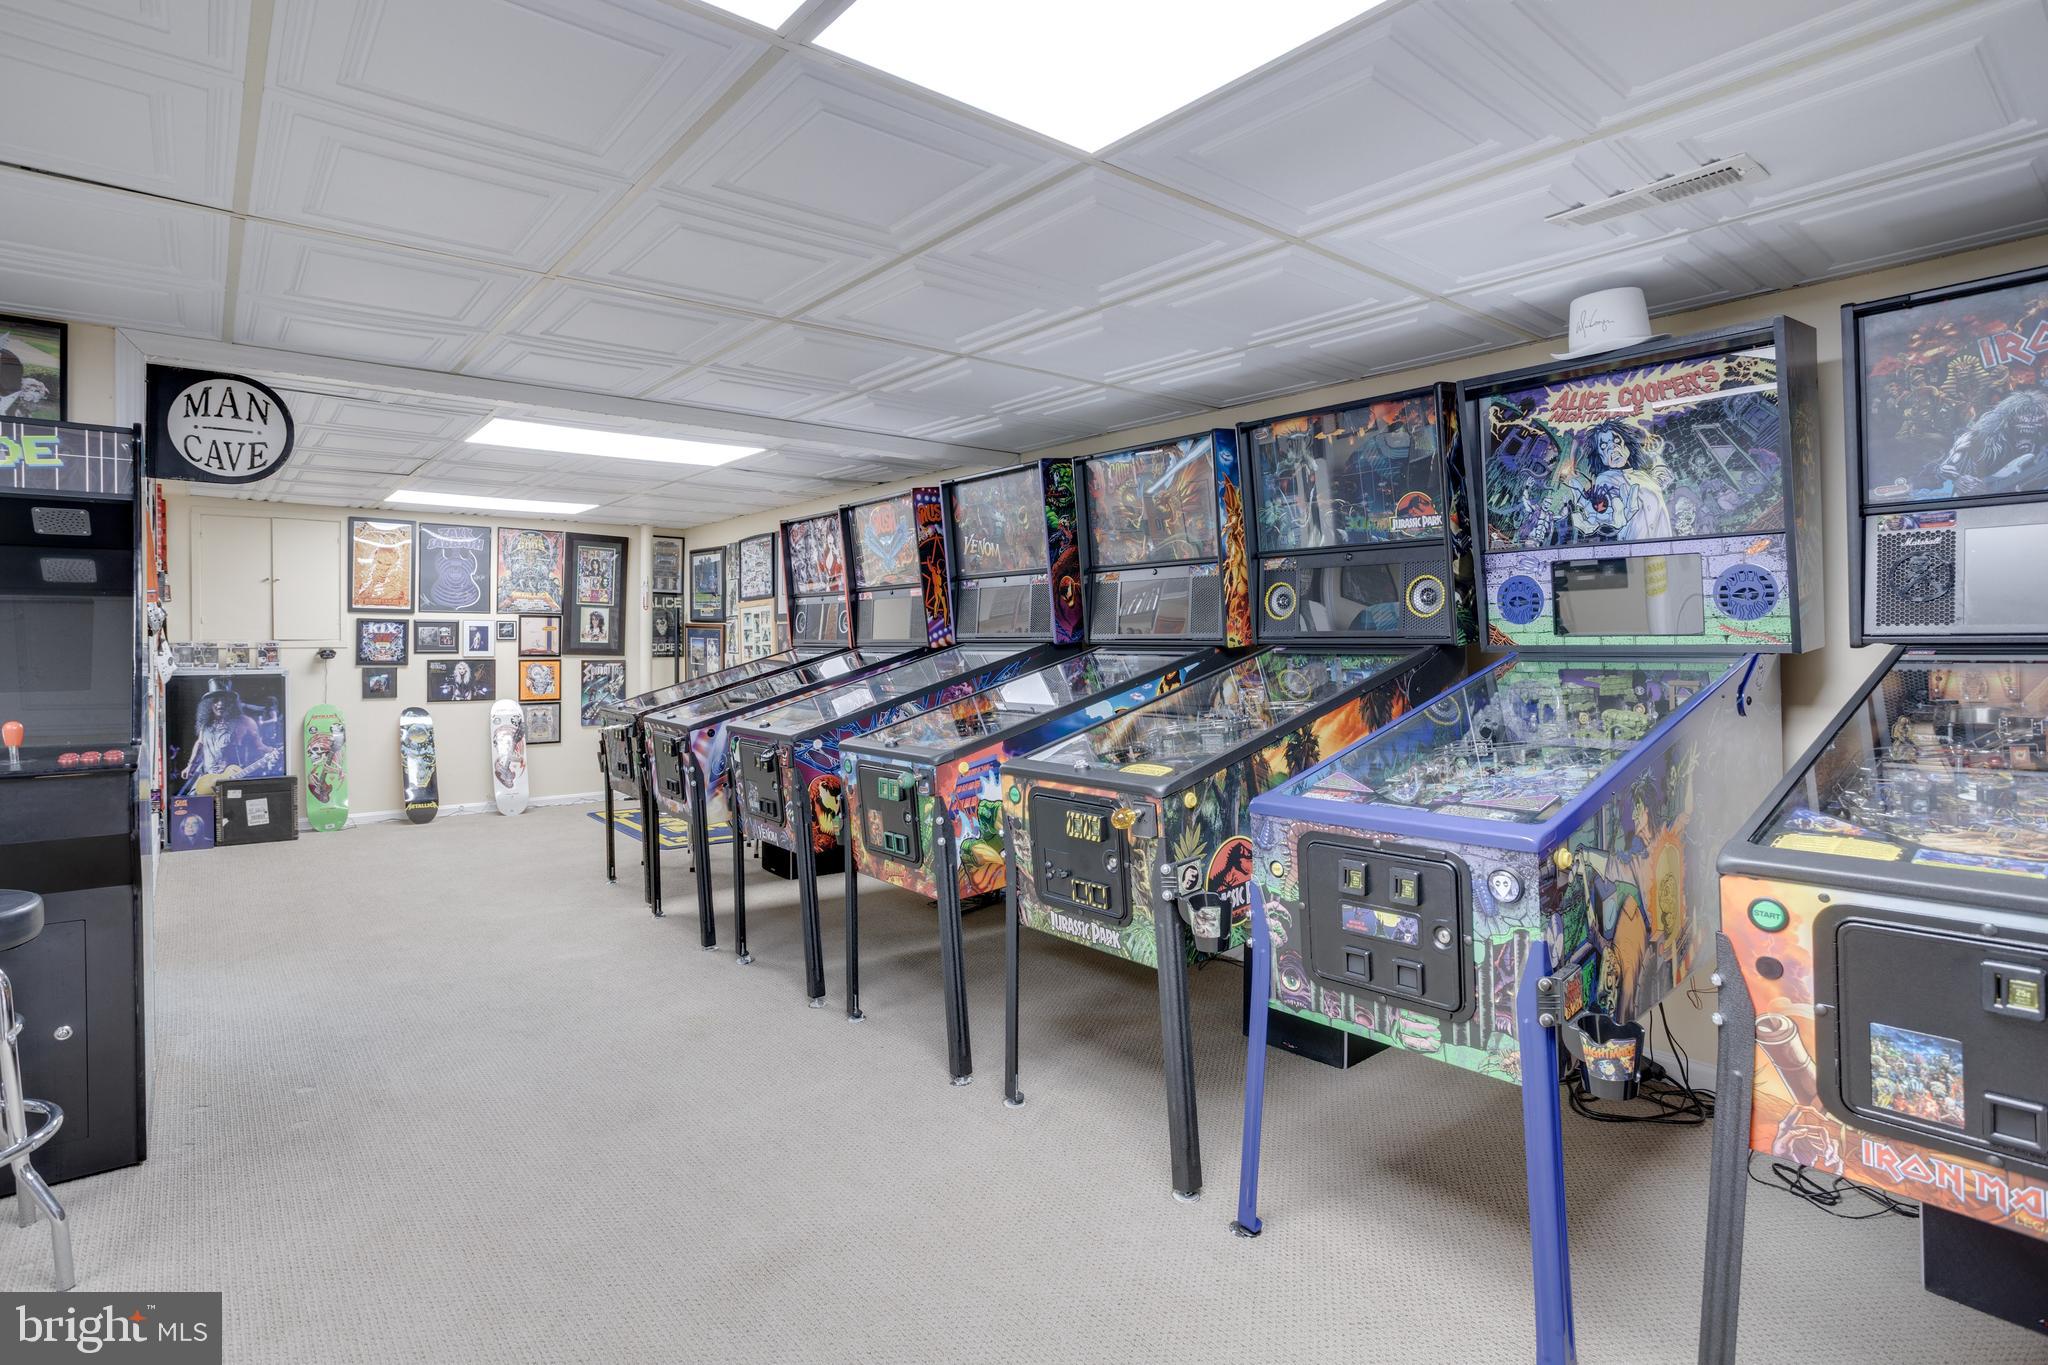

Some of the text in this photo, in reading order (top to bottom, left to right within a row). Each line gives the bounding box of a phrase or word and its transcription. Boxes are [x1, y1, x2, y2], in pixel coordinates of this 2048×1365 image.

[1550, 390, 1610, 411] ALICE
[1617, 364, 1720, 407] COOPER'S
[183, 386, 270, 426] MAN
[183, 434, 268, 471] CAVE
[918, 503, 943, 527] RUS
[1392, 515, 1443, 529] JURASSIC PARK
[964, 533, 1002, 563] VENOM
[1900, 537, 1942, 547] Marshall
[404, 801, 439, 810] METALLICA
[1050, 911, 1121, 949] JURASSIC PARK
[1753, 909, 1781, 921] START
[1862, 1138, 2048, 1219] IRON MA
